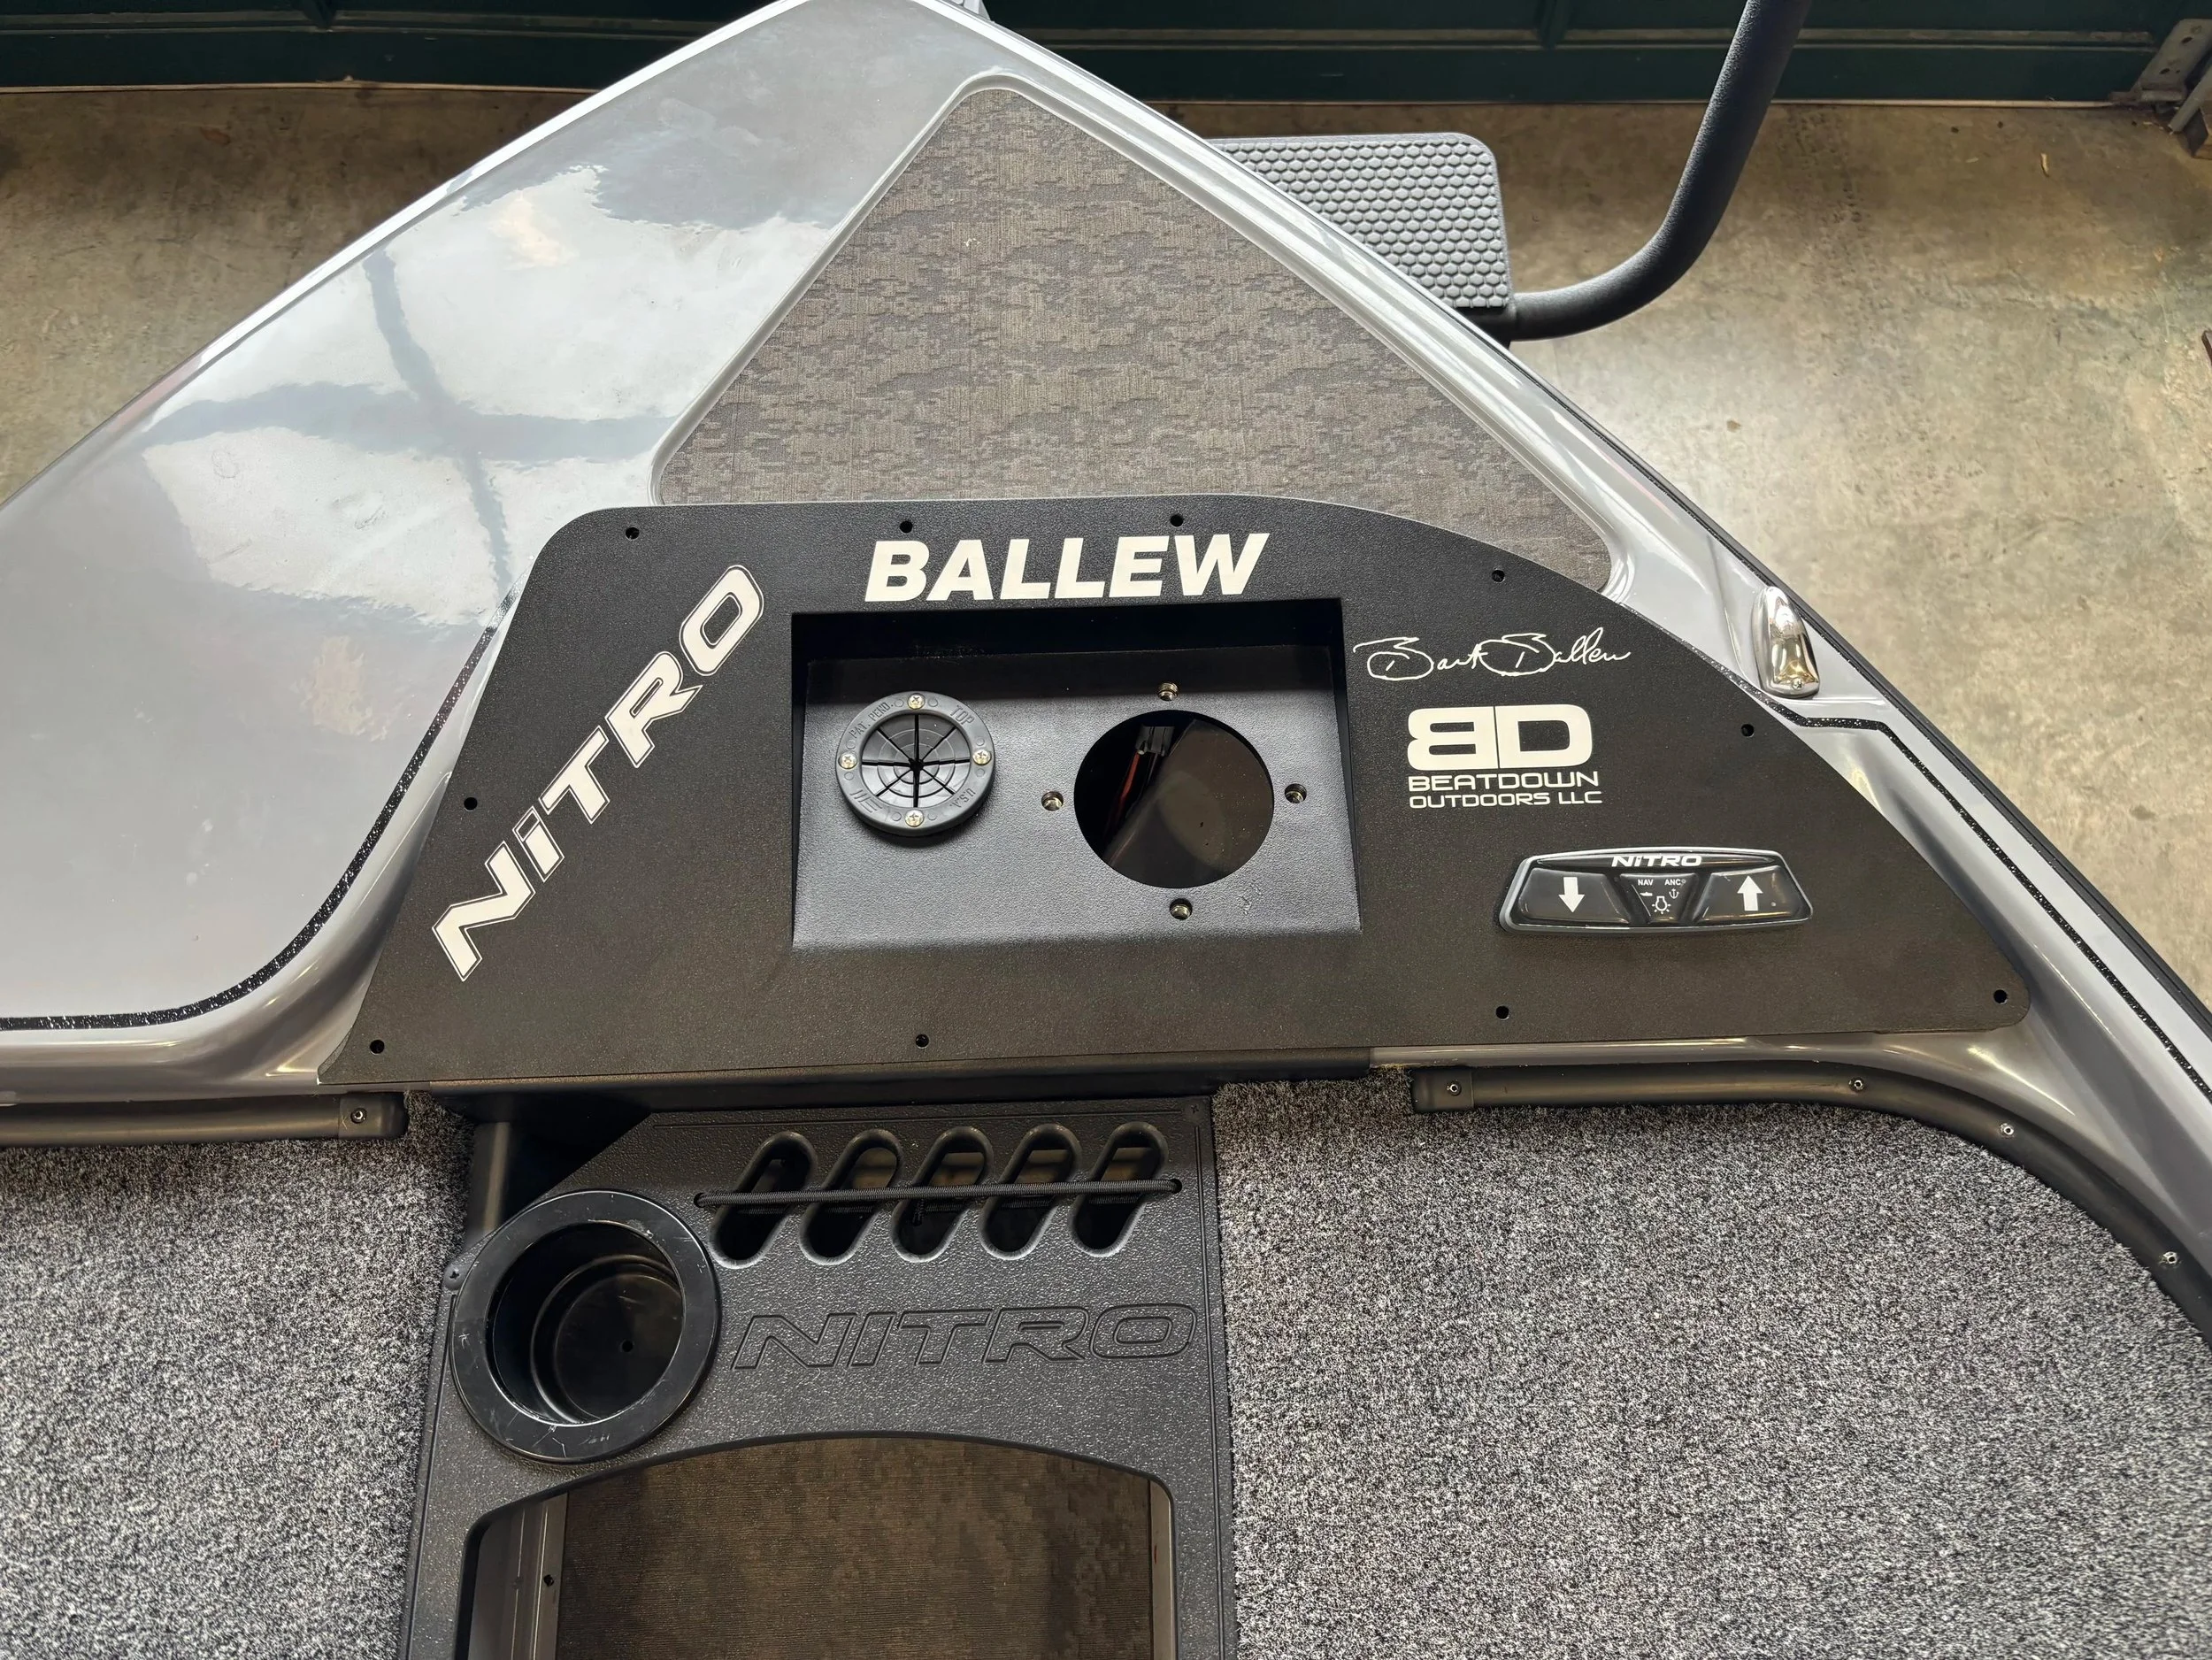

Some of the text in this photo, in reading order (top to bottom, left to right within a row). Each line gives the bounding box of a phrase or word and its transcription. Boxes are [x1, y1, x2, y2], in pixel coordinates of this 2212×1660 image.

[864, 533, 1270, 602] BALLEW
[950, 704, 975, 726] TOP
[1408, 771, 1599, 792] BEATDOWN
[1409, 791, 1602, 809] OUTDOORS LLC
[731, 1303, 1197, 1370] NITRO
